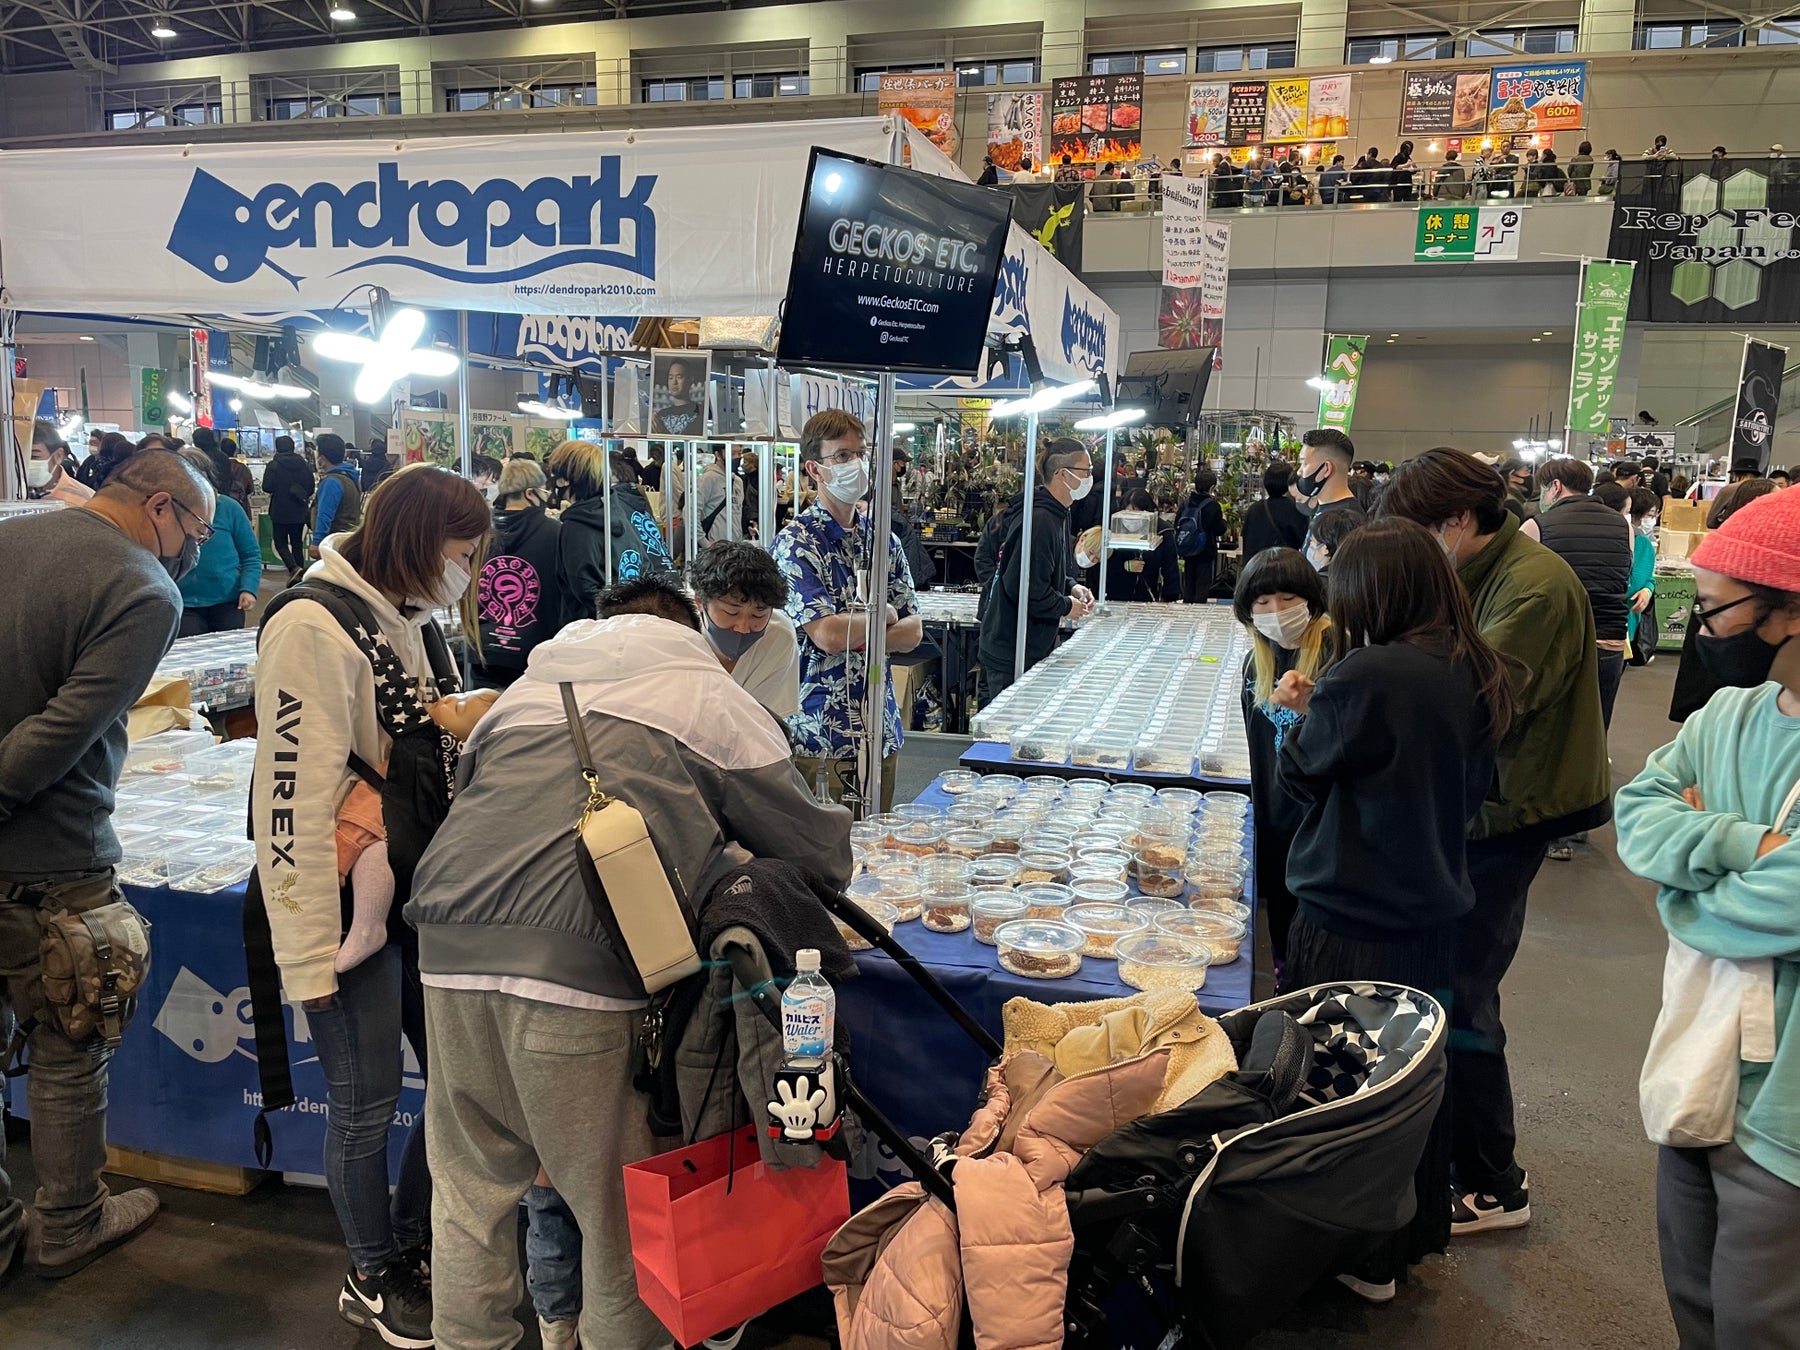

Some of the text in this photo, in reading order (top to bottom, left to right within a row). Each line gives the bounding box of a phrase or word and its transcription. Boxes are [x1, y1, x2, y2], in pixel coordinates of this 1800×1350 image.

[1497, 76, 1581, 99] 富士宮やきそば
[1546, 106, 1576, 117] 600円
[1503, 214, 1517, 224] 2F
[1619, 206, 1800, 236] Rep Fe
[829, 217, 979, 274] GECKOS ETC.
[1424, 232, 1469, 244] コーナー
[1649, 240, 1767, 264] Japan
[823, 256, 975, 294] HERPETOCULTURE
[514, 284, 656, 297] https://dendropark2010.com
[857, 292, 939, 314] www.GeckosETC.com
[1572, 331, 1600, 410] サプライ
[1589, 316, 1624, 429] エキゾチック
[271, 688, 303, 869] AVIREX
[785, 1012, 820, 1024] カルピス
[784, 1023, 821, 1037] Water
